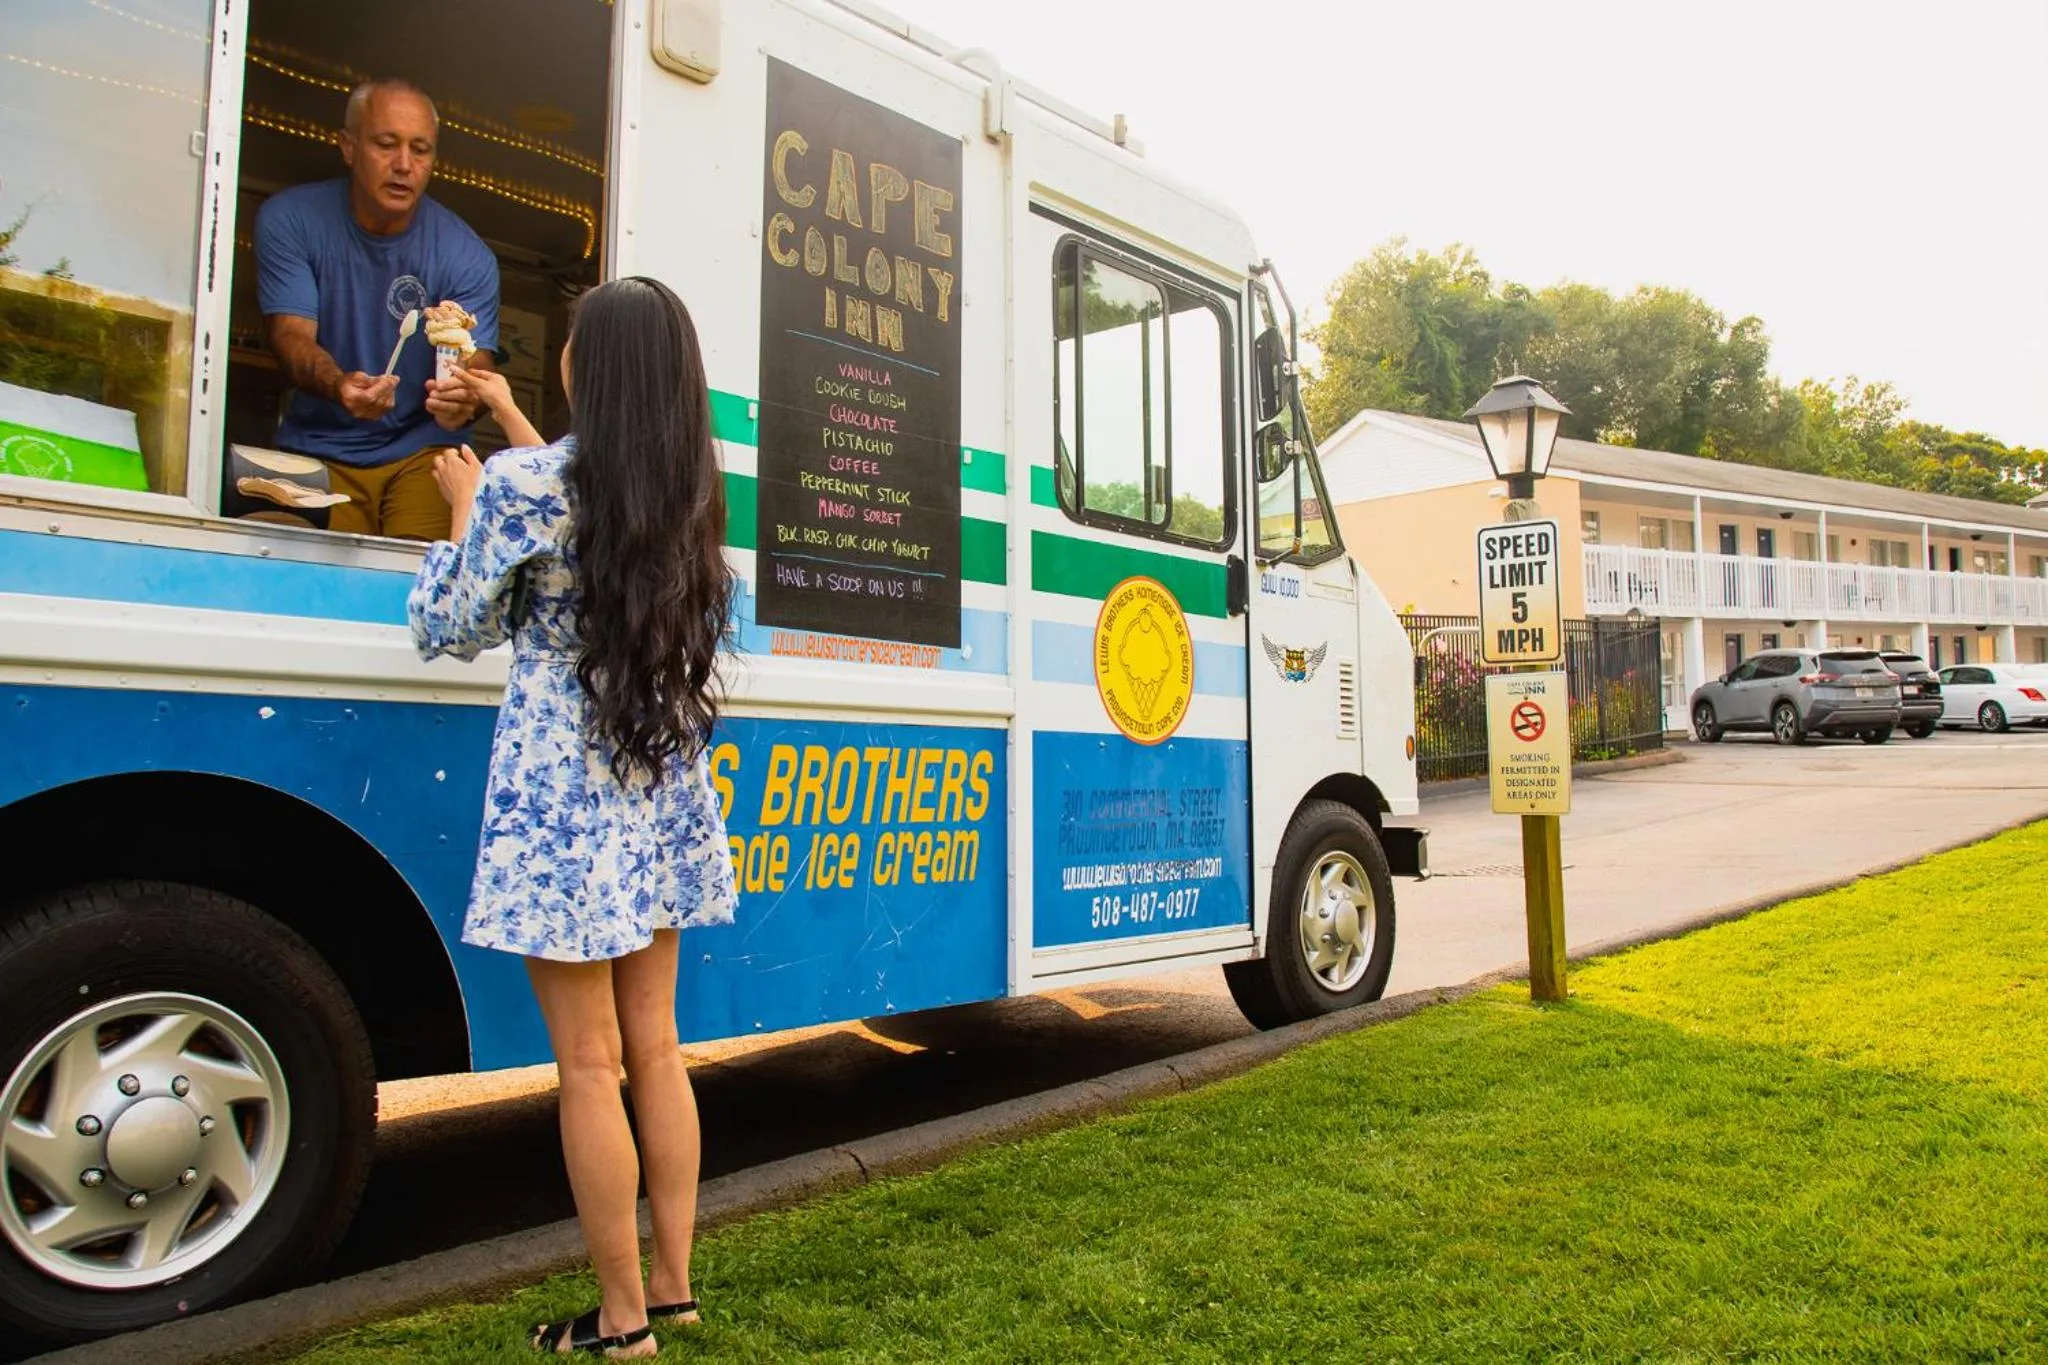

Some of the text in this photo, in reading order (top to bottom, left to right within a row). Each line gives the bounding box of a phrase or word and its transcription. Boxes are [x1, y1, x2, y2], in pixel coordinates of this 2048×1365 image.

[772, 129, 954, 258] CAPE
[767, 211, 954, 322] COLONY
[825, 287, 904, 352] INN
[839, 363, 893, 386] VANILLA
[815, 376, 907, 412] COOKIE DOUGH
[829, 403, 898, 434] CHOCOLATE
[823, 428, 894, 456] PISTACHIO
[829, 455, 881, 475] COFFEE
[800, 471, 911, 507] PEPPERMINT STICK
[818, 498, 902, 528] MANGO SORBET
[861, 538, 887, 553] CHIP
[891, 538, 931, 560] YOGURT
[1485, 531, 1550, 560] SPEED
[776, 562, 809, 588] HAVE
[815, 573, 823, 589] A
[827, 573, 862, 593] SCOOP
[868, 580, 884, 596] ON
[888, 580, 905, 598] US
[1488, 561, 1547, 589] LIMIT
[1103, 588, 1134, 632] BROTHERS
[1511, 591, 1528, 623] 5
[1174, 620, 1185, 639] ICE
[1497, 627, 1544, 654] MPH
[1100, 634, 1110, 674] LEWIS
[1180, 643, 1190, 685] CREAM
[1524, 686, 1545, 695] INN
[1106, 688, 1184, 735] PROVINCETOWN CAPE COD
[1501, 765, 1560, 775] PERMITTED IN
[1510, 752, 1551, 762] SMOKING
[758, 743, 994, 826] BROTHERS
[1505, 778, 1557, 787] DESIGNATED
[1507, 790, 1557, 799] AREAS ONLY
[1179, 788, 1222, 817] STREET
[1165, 820, 1185, 849] MA
[1190, 818, 1226, 848] 02657
[805, 832, 861, 891] ice
[872, 829, 980, 887] cream
[1091, 887, 1200, 929] 508-487-0977
